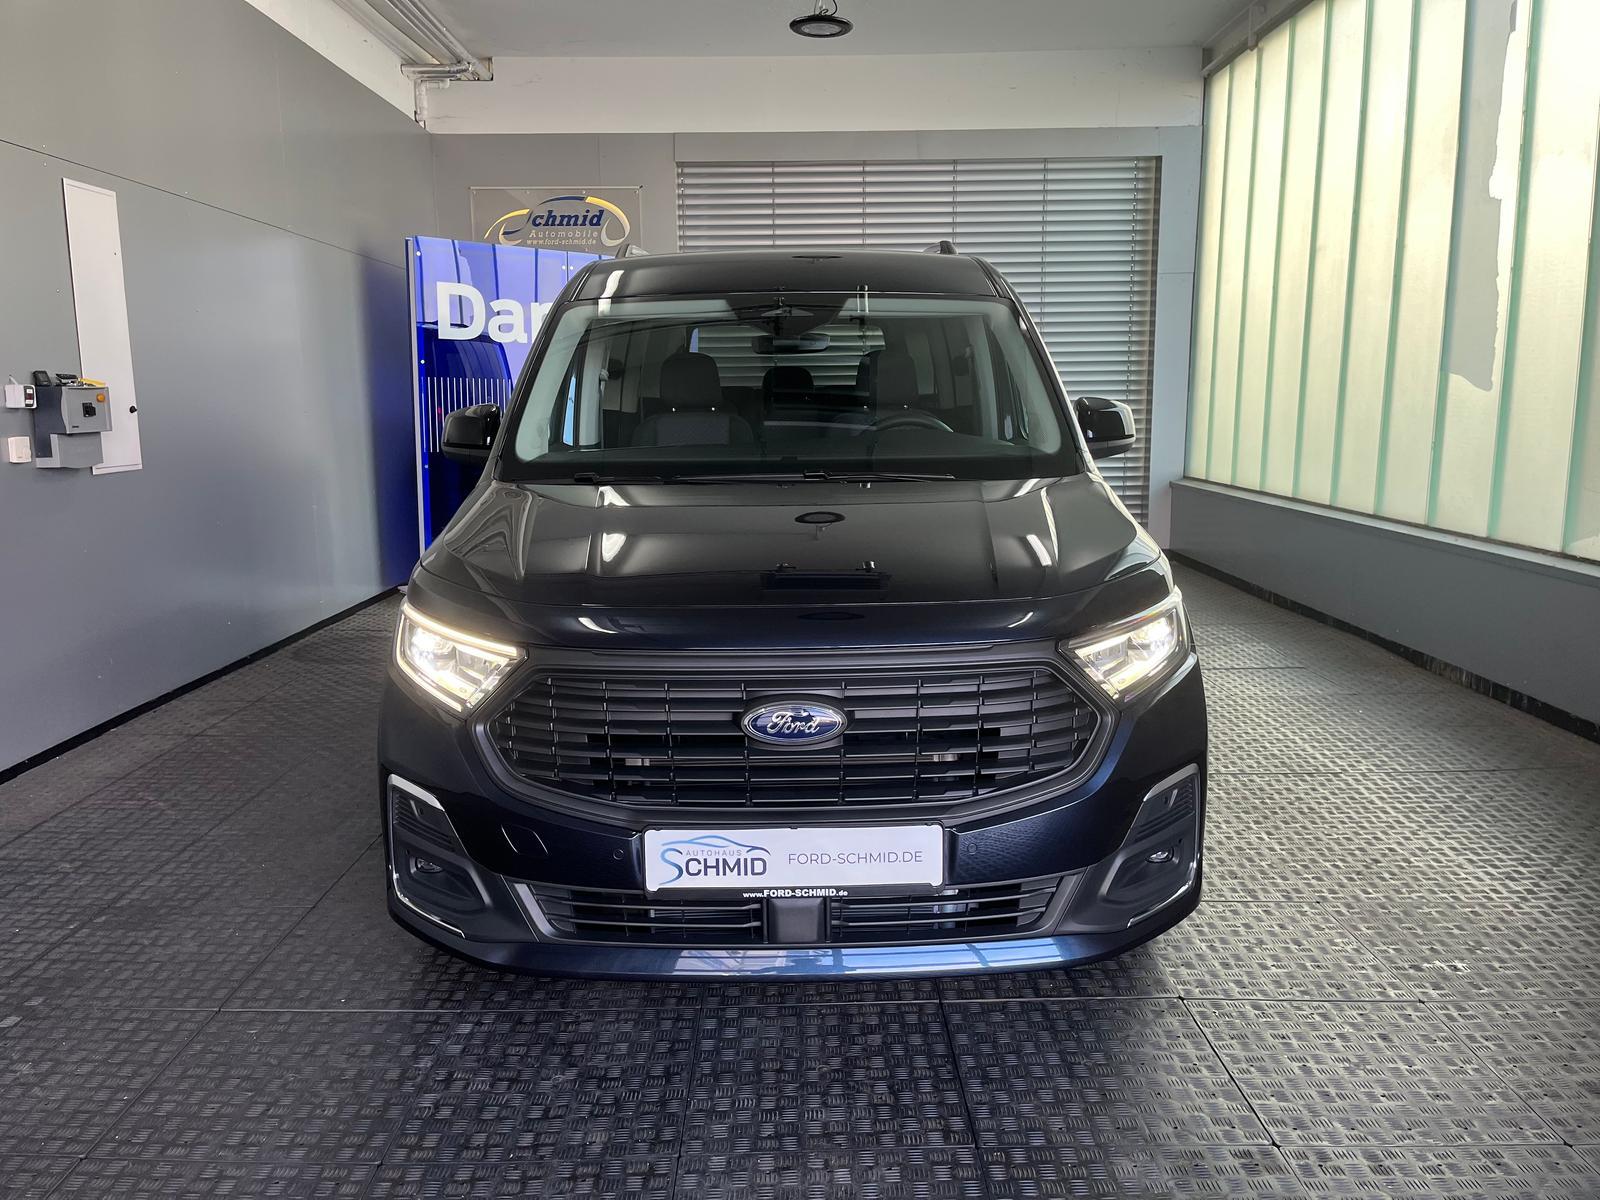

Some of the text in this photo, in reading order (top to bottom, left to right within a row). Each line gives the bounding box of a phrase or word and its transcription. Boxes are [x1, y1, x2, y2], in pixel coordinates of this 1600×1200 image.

[529, 230, 599, 238] Automobile
[526, 238, 597, 246] www.ford-schmid.de
[766, 711, 820, 734] Ford
[686, 849, 743, 857] AUTOHAUS
[788, 850, 924, 865] FORD-SCHMID.DE
[660, 848, 768, 885] SCHMID
[742, 888, 849, 898] www.FORD-SCHMID.de
